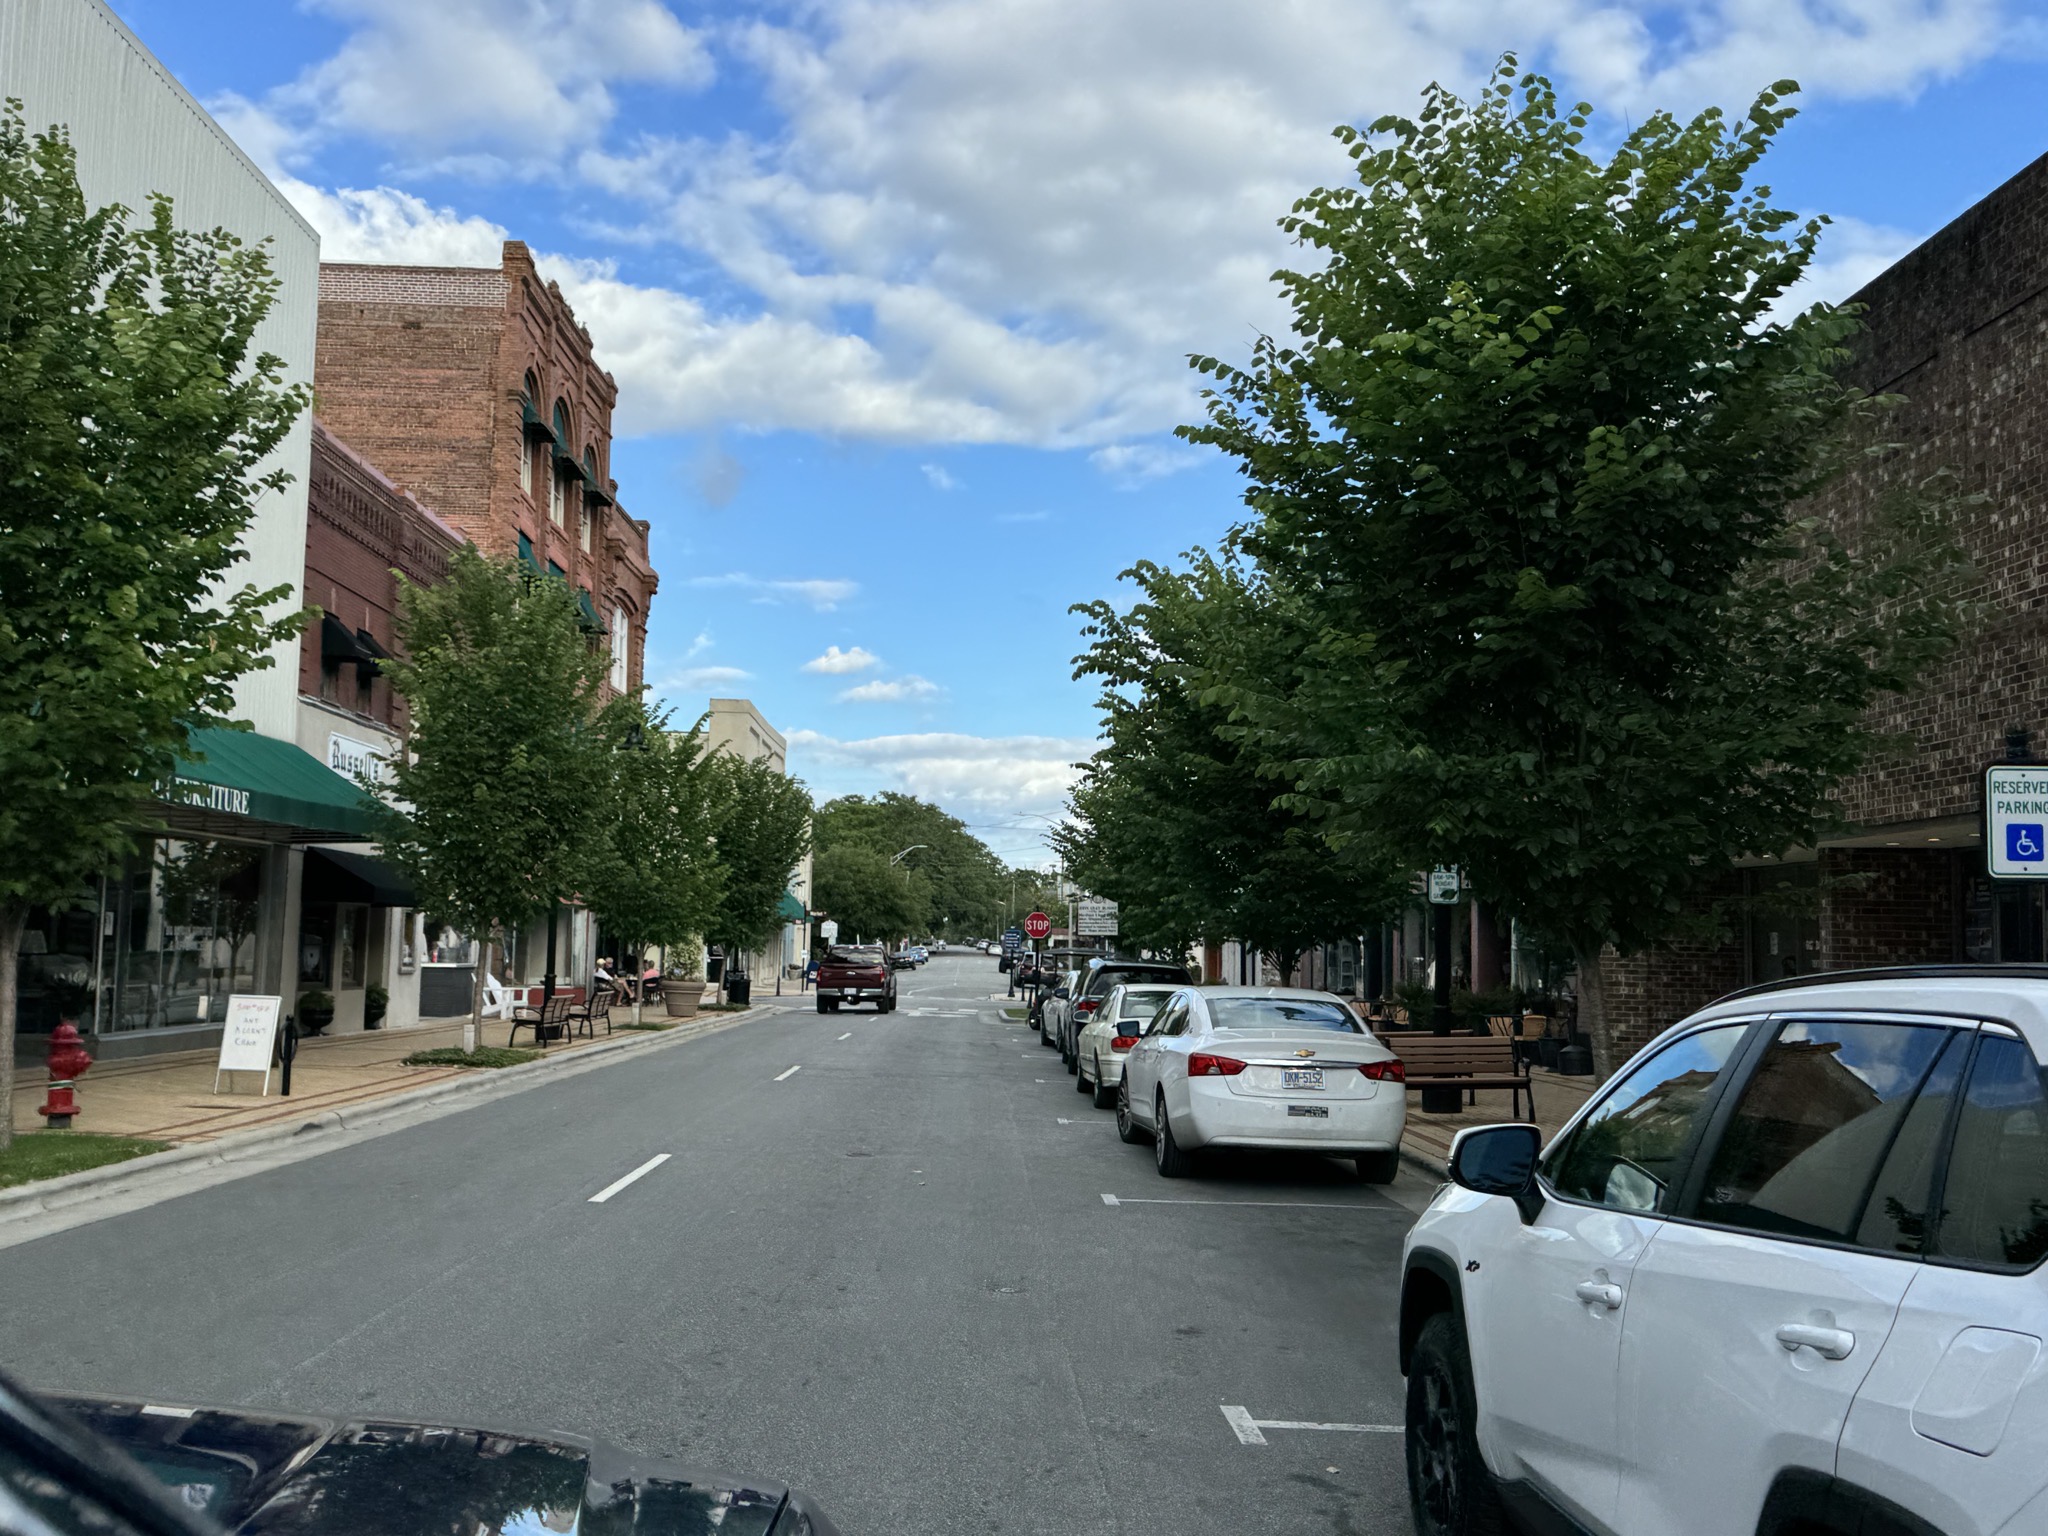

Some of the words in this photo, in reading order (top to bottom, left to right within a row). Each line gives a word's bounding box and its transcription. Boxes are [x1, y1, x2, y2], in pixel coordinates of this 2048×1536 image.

[1993, 781, 2048, 795] RESERVE
[1997, 801, 2048, 815] PARKING
[1027, 920, 1049, 930] STOP
